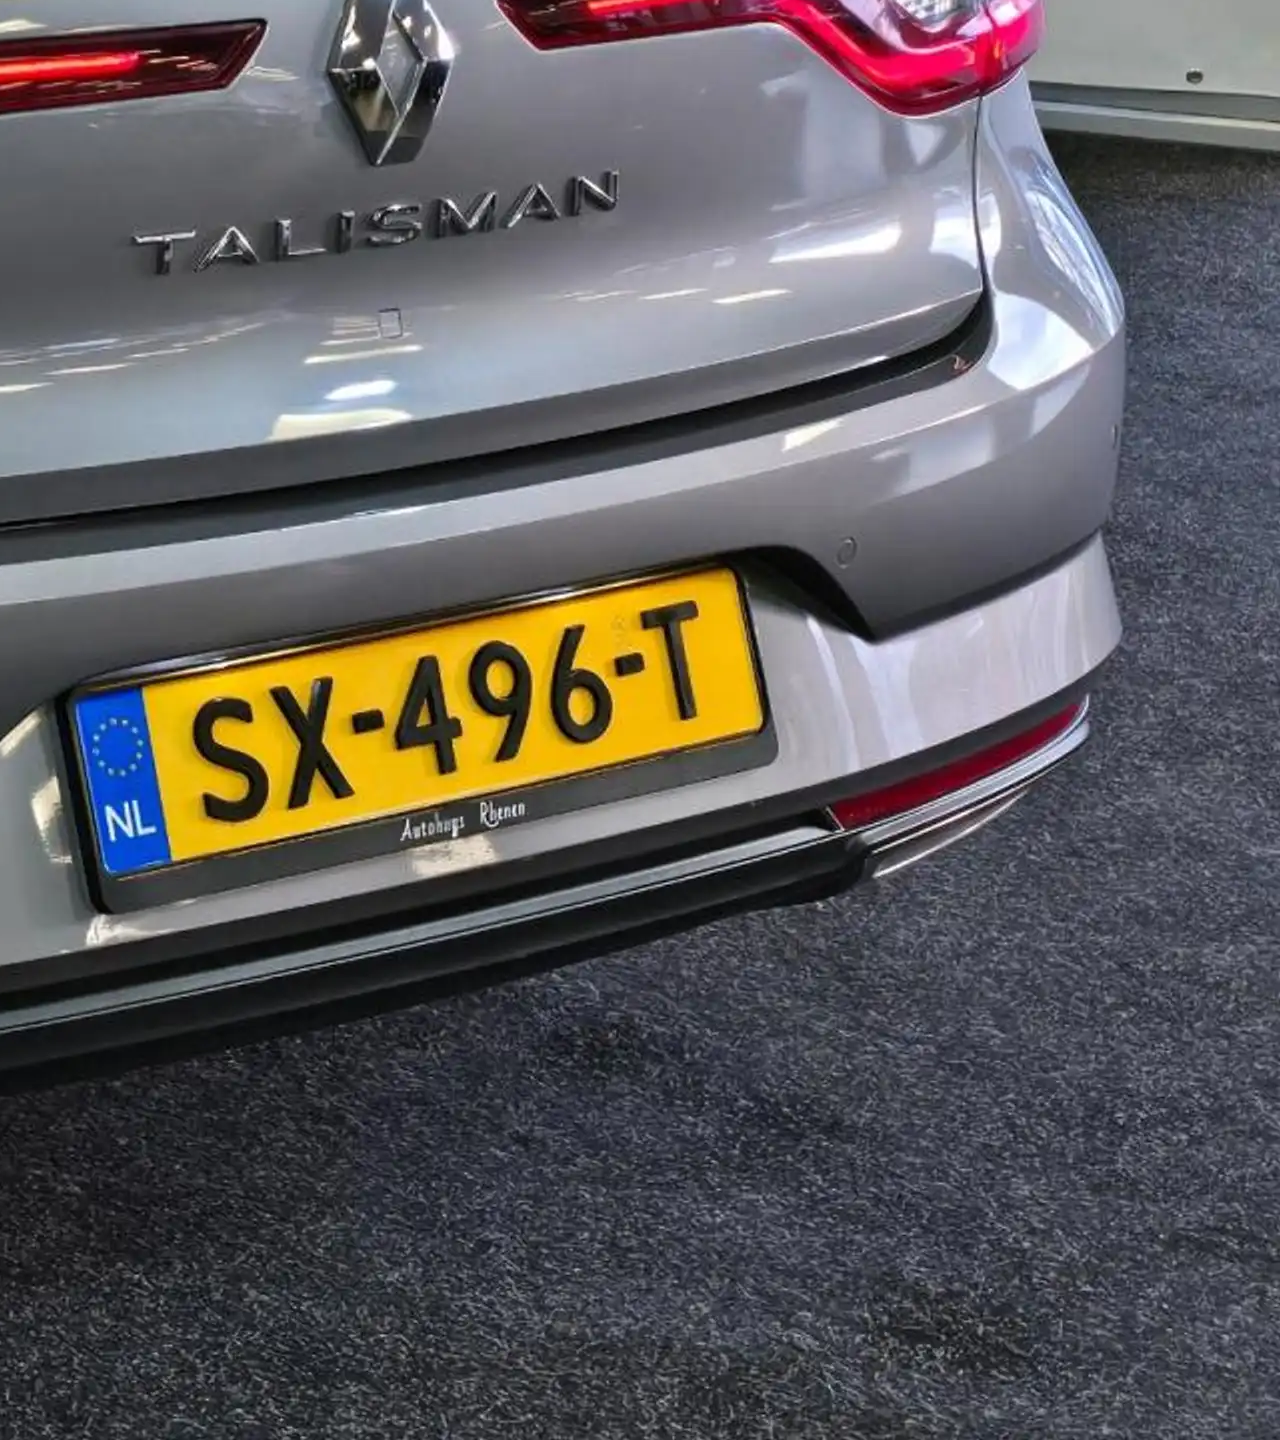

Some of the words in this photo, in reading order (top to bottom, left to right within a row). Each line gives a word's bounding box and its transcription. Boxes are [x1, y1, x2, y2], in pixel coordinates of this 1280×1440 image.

[131, 168, 621, 275] TALISMAN
[103, 798, 157, 843] NL
[191, 598, 701, 823] SX-496-T
